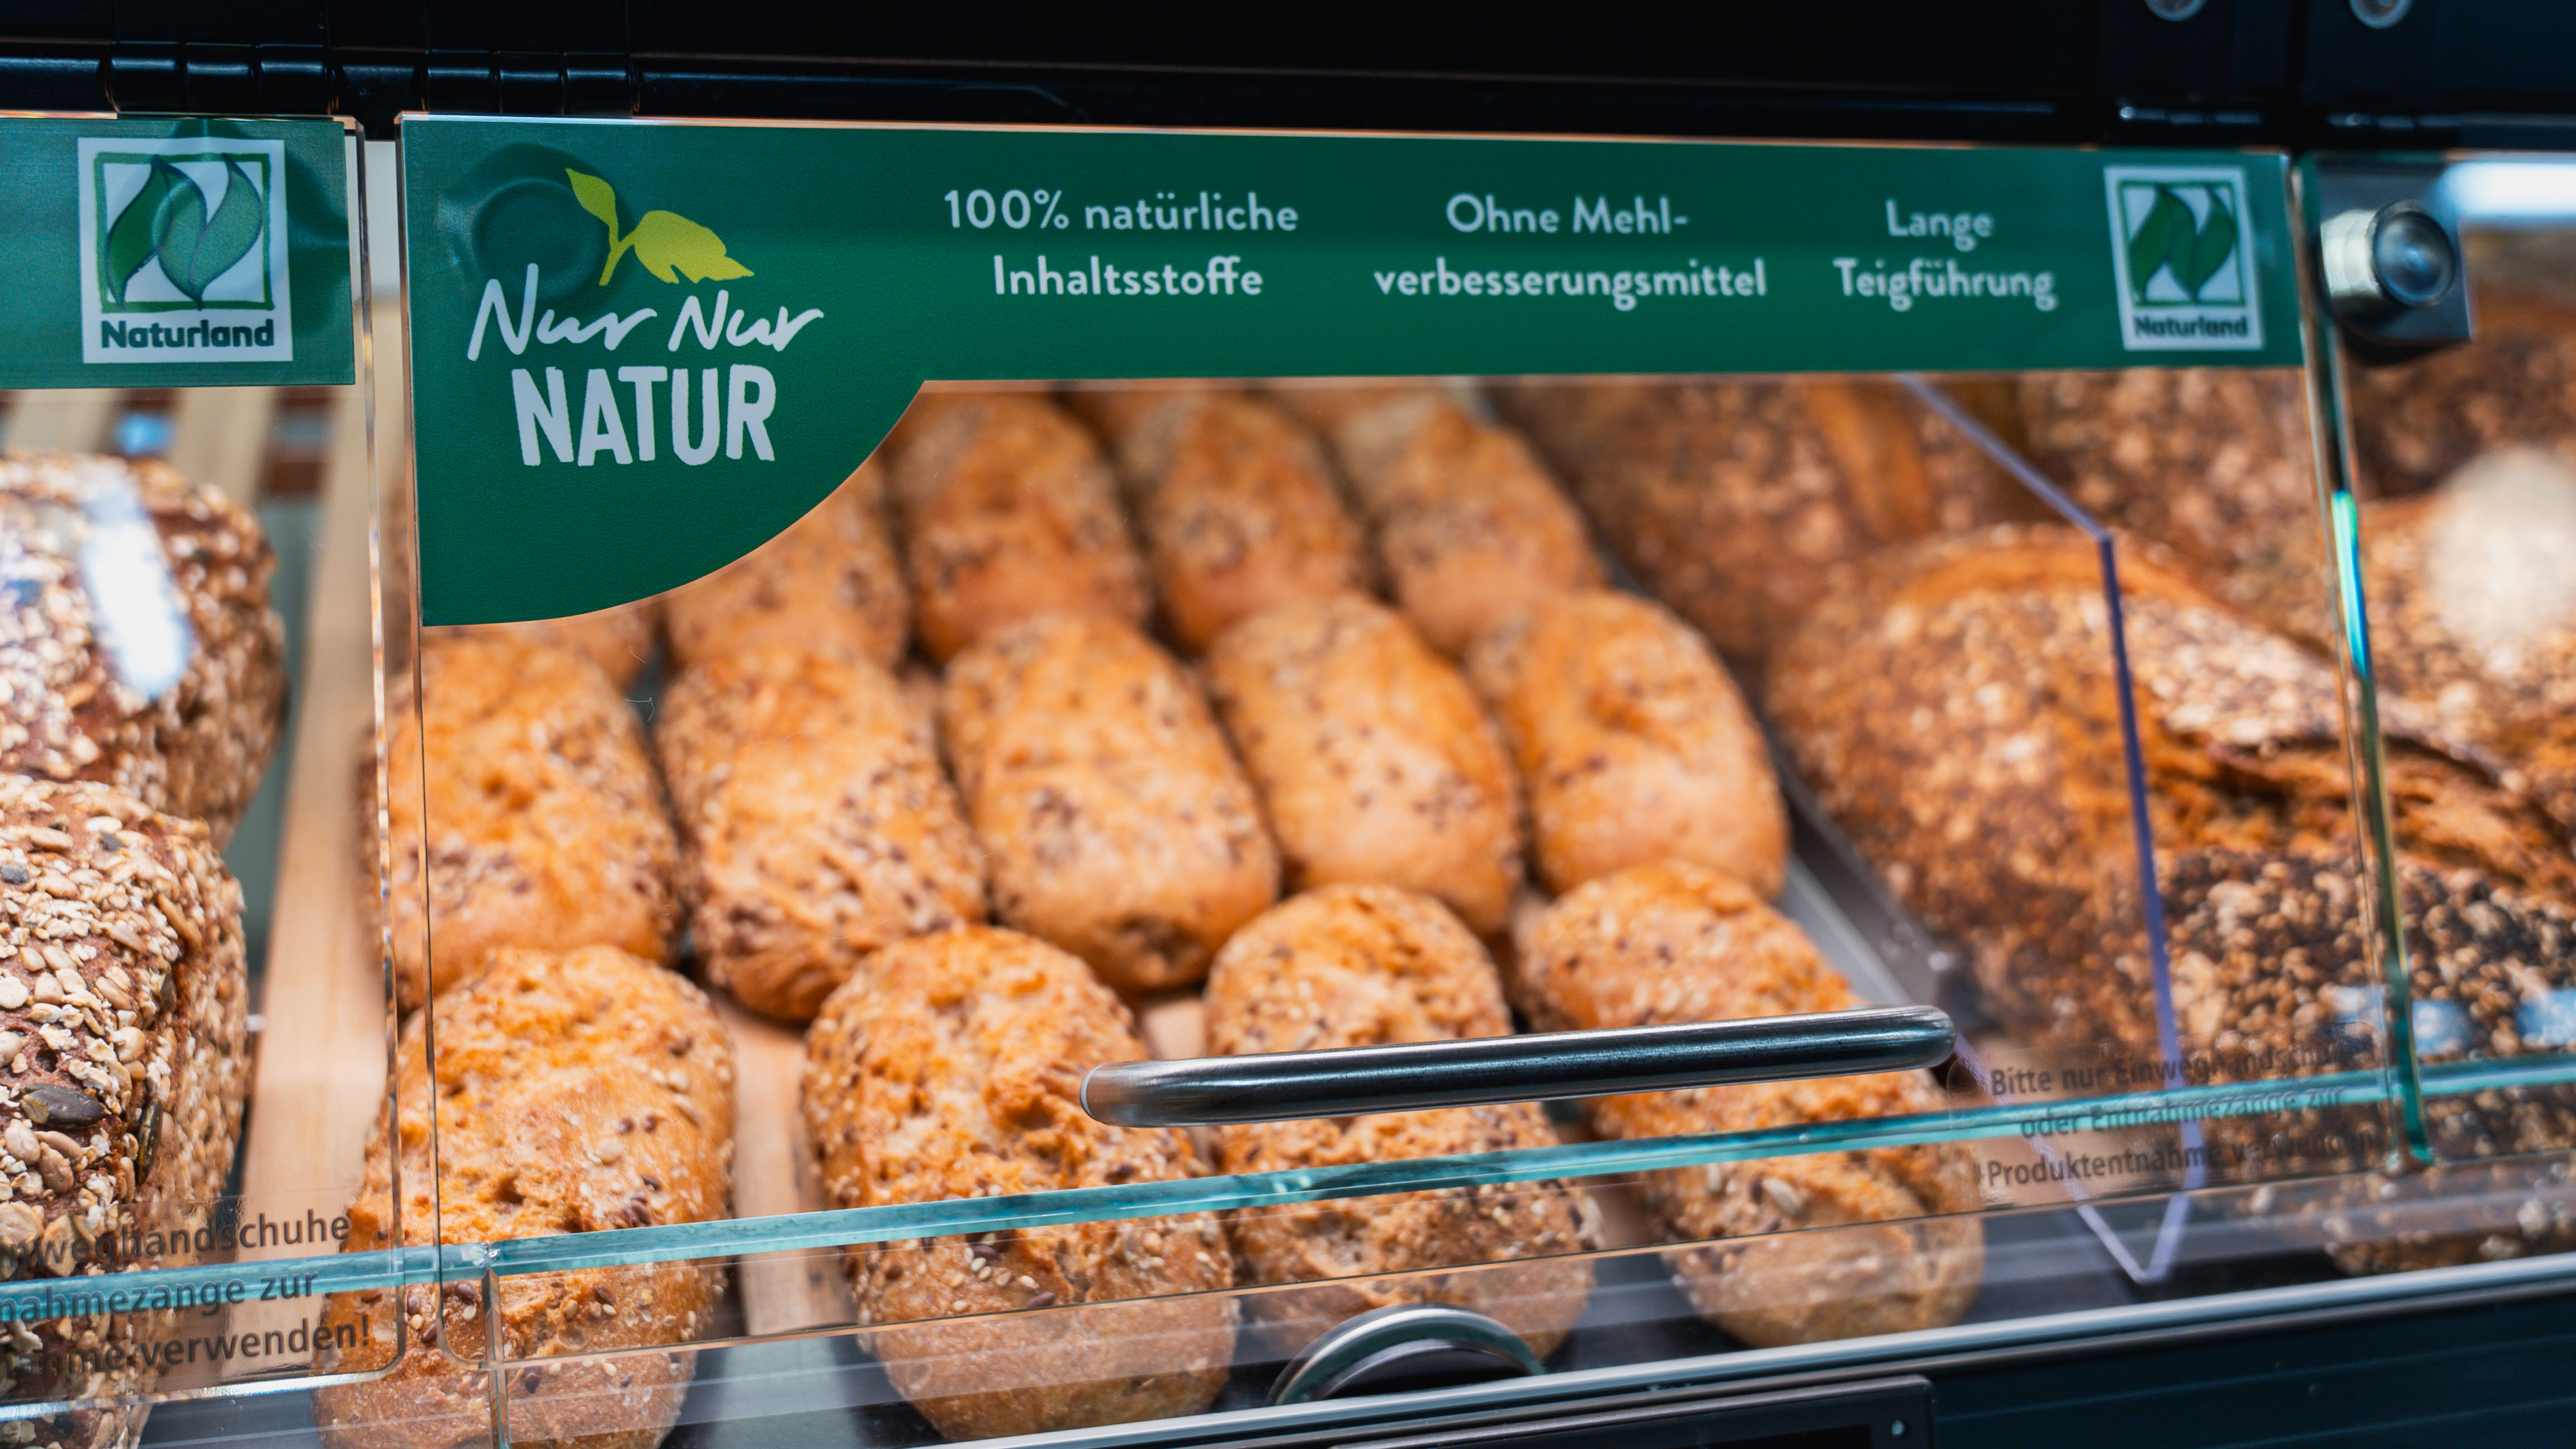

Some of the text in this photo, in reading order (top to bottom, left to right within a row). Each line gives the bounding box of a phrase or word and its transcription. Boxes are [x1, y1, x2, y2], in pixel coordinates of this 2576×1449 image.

[944, 189, 1299, 231] 100% natürliche
[1446, 193, 1689, 234] Ohne Mehl-
[1886, 197, 1994, 252] Lange
[994, 255, 1264, 296] Inhaltsstoffe
[1373, 255, 1768, 311] verbesserungsmittel
[1832, 257, 2059, 312] Teigführung
[467, 263, 825, 361] Nur Nur
[2133, 314, 2248, 337] Naturland
[101, 319, 274, 348] Naturland
[511, 364, 776, 466] NATUR
[1991, 1066, 2052, 1096] Bitte
[2020, 1105, 2078, 1138] oder
[1987, 1137, 2221, 1187] Produktentnahme
[261, 1271, 319, 1301] zur
[140, 1315, 370, 1367] verwenden!
